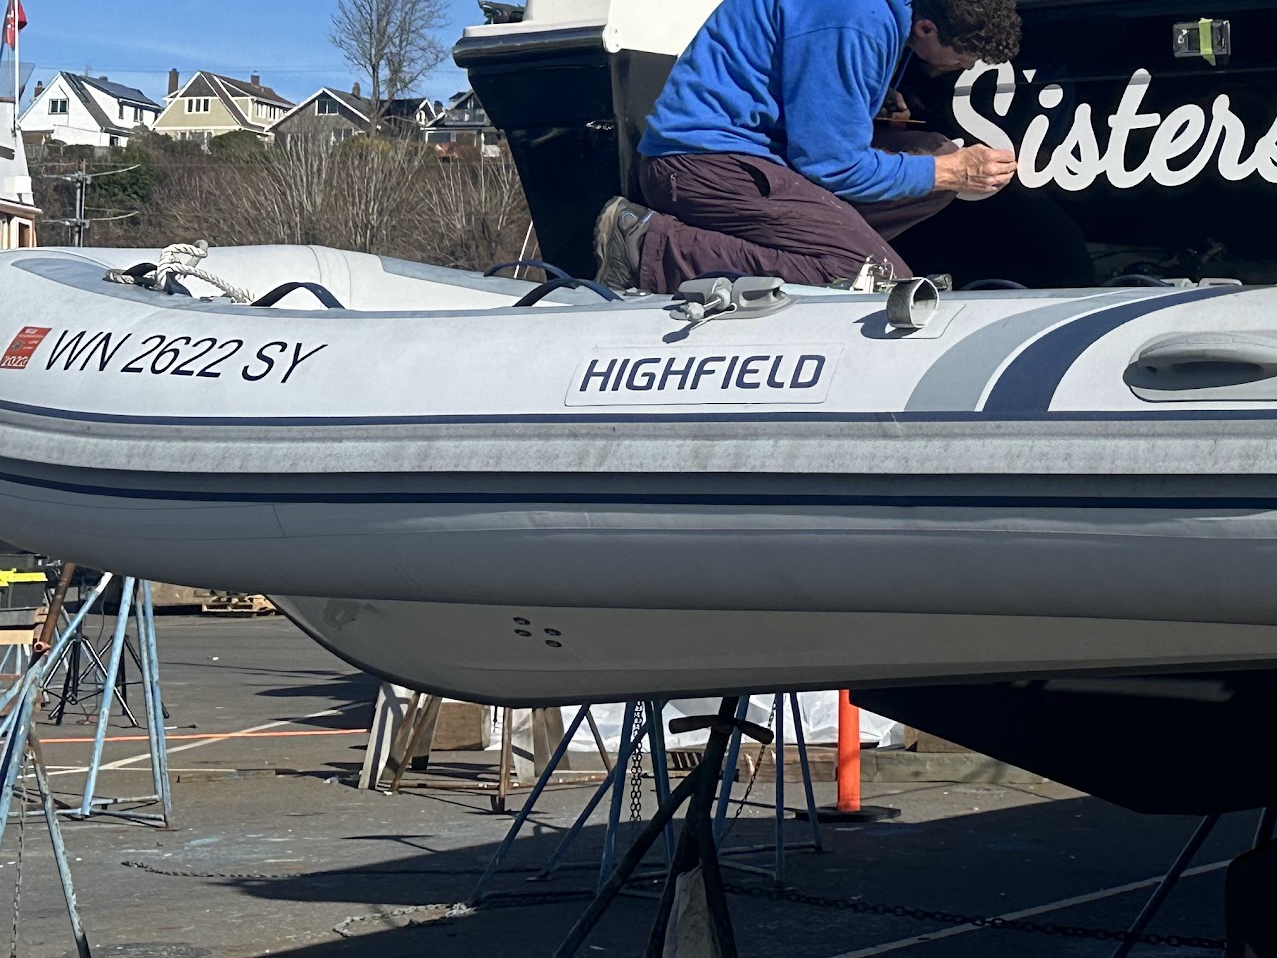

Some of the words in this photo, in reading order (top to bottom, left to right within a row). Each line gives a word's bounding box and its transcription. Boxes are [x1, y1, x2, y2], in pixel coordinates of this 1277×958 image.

[46, 329, 132, 372] WN
[121, 334, 243, 378] 2622
[242, 340, 328, 384] SY
[579, 354, 826, 392] HIGHFIELD
